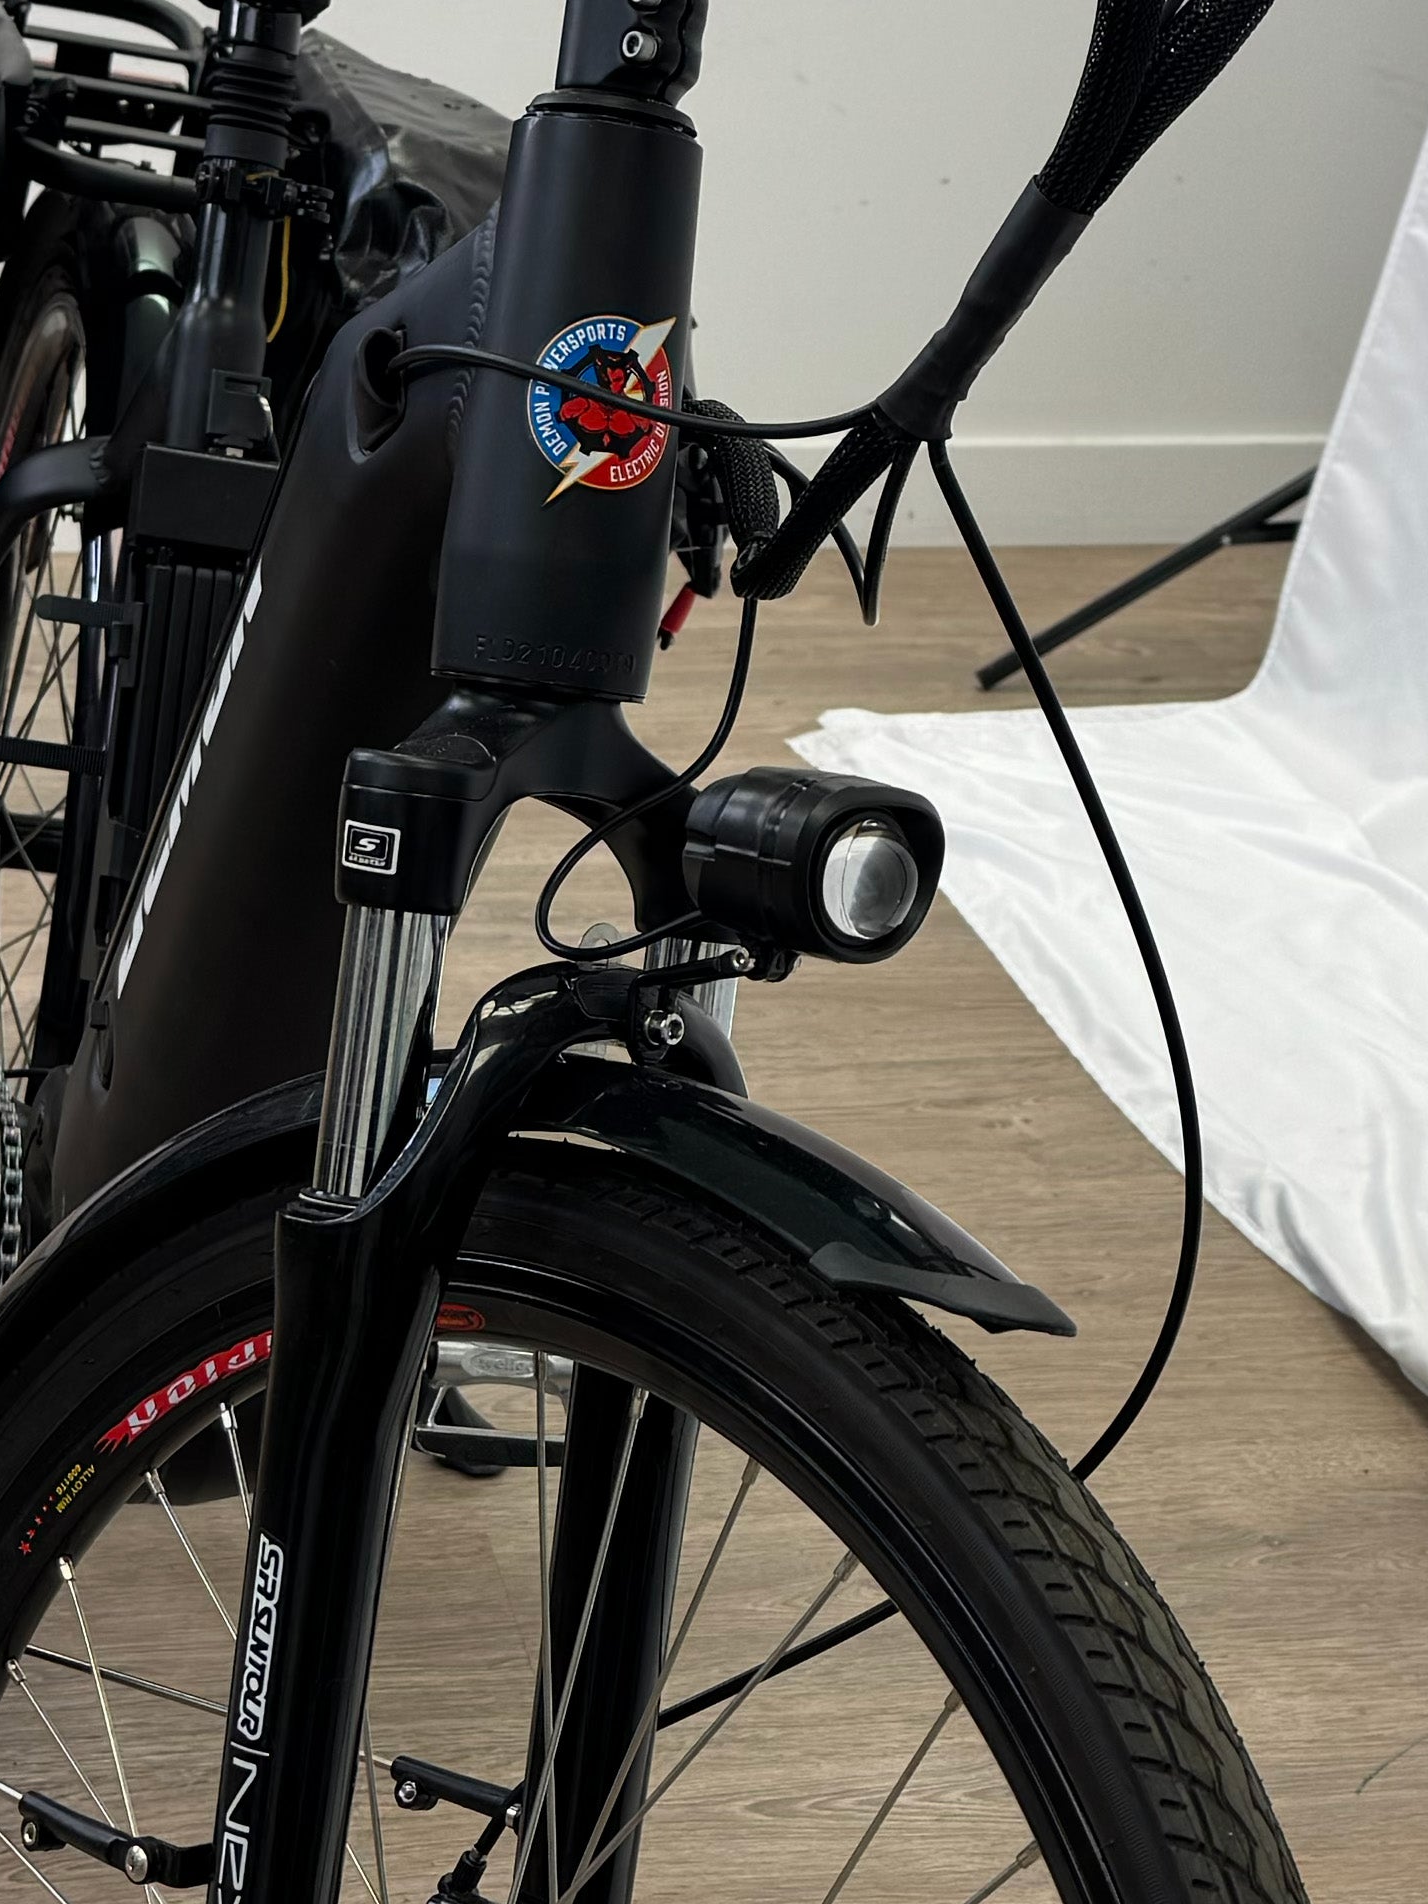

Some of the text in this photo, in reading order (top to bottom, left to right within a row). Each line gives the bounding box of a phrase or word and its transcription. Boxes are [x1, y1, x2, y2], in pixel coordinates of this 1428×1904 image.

[534, 322, 627, 457] DEMON PWERSPORTS
[609, 369, 670, 483] ELECTRIC DISION
[129, 1335, 273, 1435] PION
[71, 1464, 95, 1498] ALLOY
